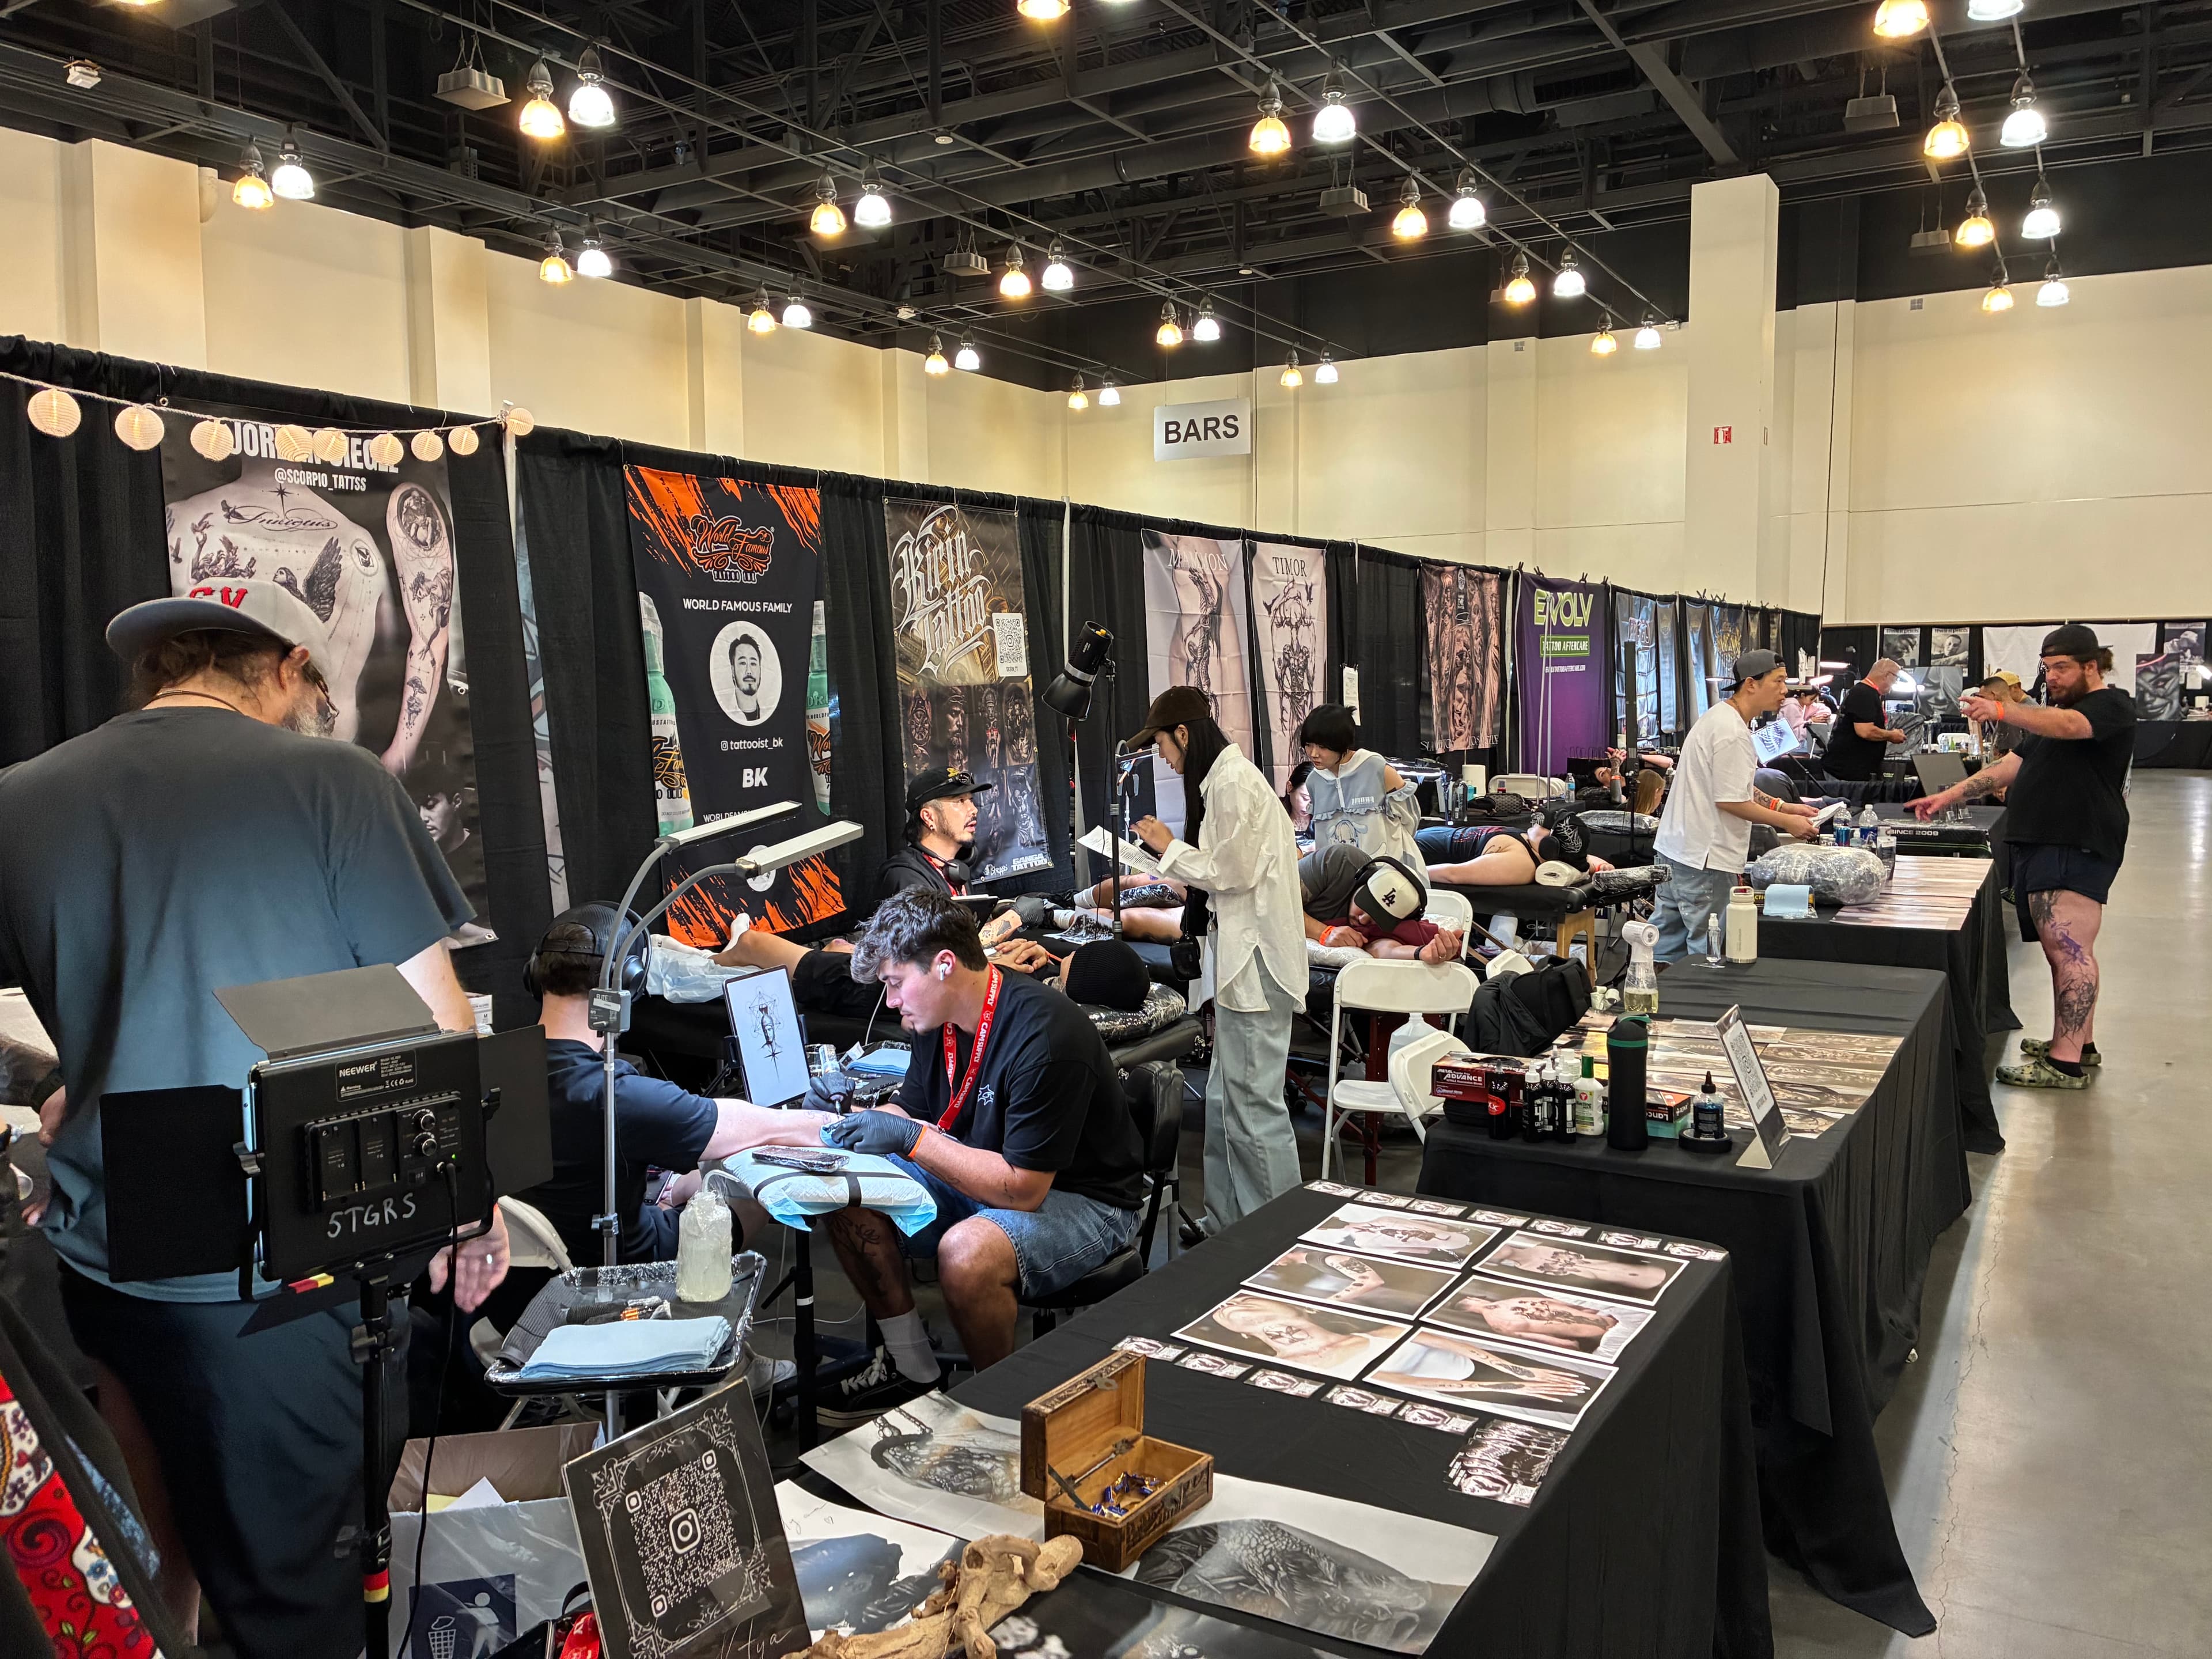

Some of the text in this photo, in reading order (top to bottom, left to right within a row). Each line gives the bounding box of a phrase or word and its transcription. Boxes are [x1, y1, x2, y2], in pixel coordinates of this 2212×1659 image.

[1165, 415, 1239, 444] BARS
[231, 422, 321, 464] JOR
[274, 468, 366, 491] @SCORPIO_TATTSS
[692, 518, 771, 560] World Famous
[891, 505, 987, 612] Kirin
[1168, 548, 1228, 571] MAMMON
[1272, 557, 1307, 577] TIMOR
[714, 570, 740, 582] TATTOO
[683, 598, 793, 613] WORLD FAMOUS FAMILY
[1534, 589, 1593, 627] EVOLV
[899, 575, 995, 681] Tattoo
[1542, 641, 1588, 651] TATTOO AFTERCARE
[730, 738, 783, 751] tattooist_bk
[742, 767, 768, 788] BK
[1012, 858, 1048, 871] TATTOO
[1382, 888, 1396, 907] LA
[339, 1063, 375, 1078] NEEWER
[1444, 1073, 1483, 1082] ADVANCE
[1646, 1112, 1669, 1121] Lanc
